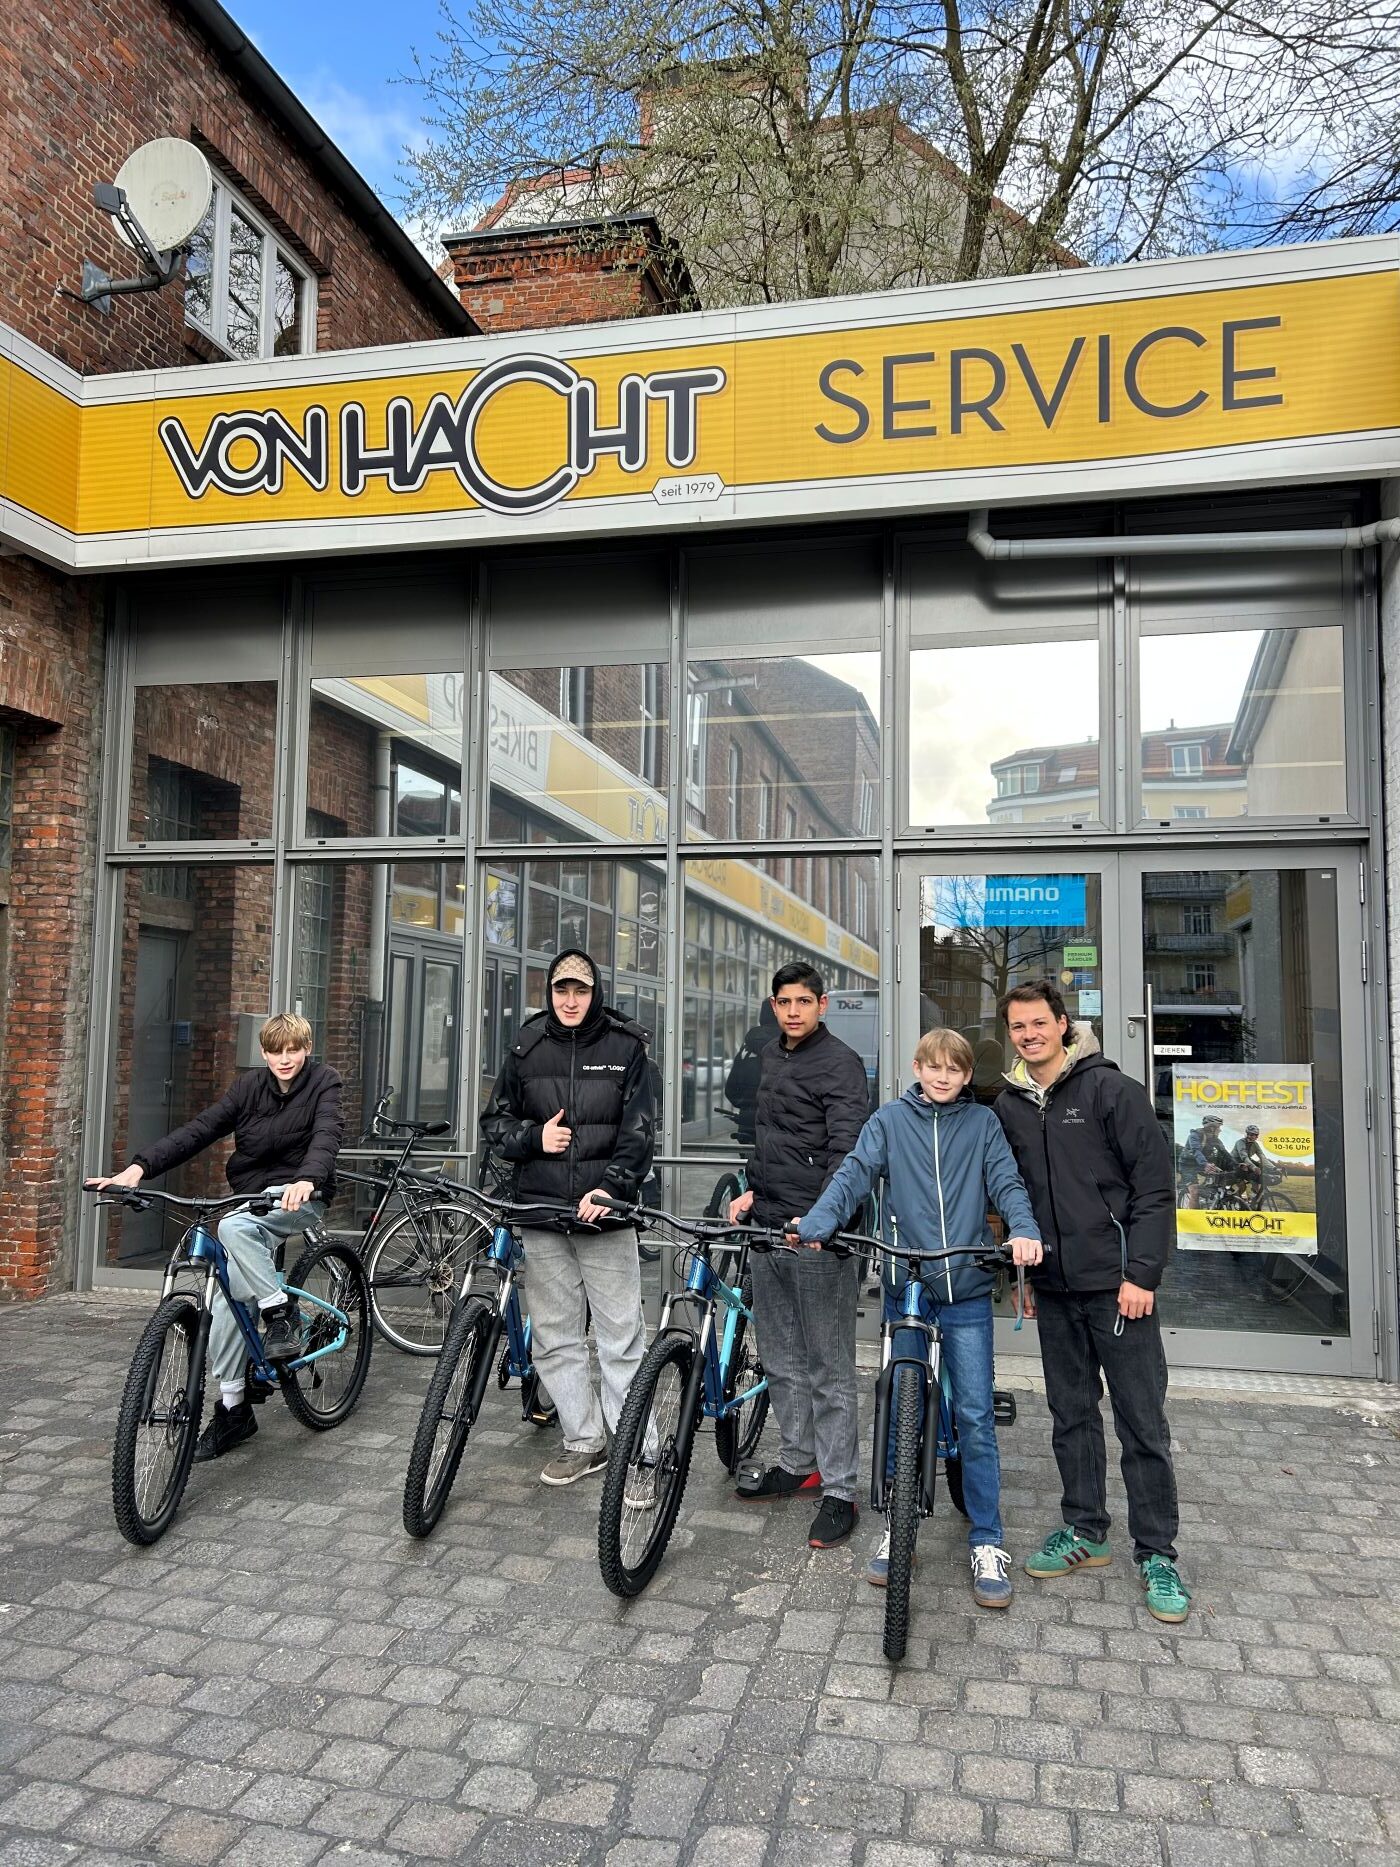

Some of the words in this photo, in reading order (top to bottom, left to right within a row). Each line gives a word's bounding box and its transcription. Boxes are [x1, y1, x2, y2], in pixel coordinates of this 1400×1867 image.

[814, 315, 1284, 445] SERVICE
[158, 406, 328, 500] VON
[340, 352, 727, 516] HACHT
[661, 483, 682, 497] seit
[686, 481, 715, 495] 1979
[984, 886, 1060, 902] IMANO
[1175, 1080, 1312, 1104] HOFFEST
[1268, 1136, 1311, 1144] 28.03.2026
[1205, 1216, 1231, 1229] VON
[1232, 1214, 1285, 1234] HACHT
